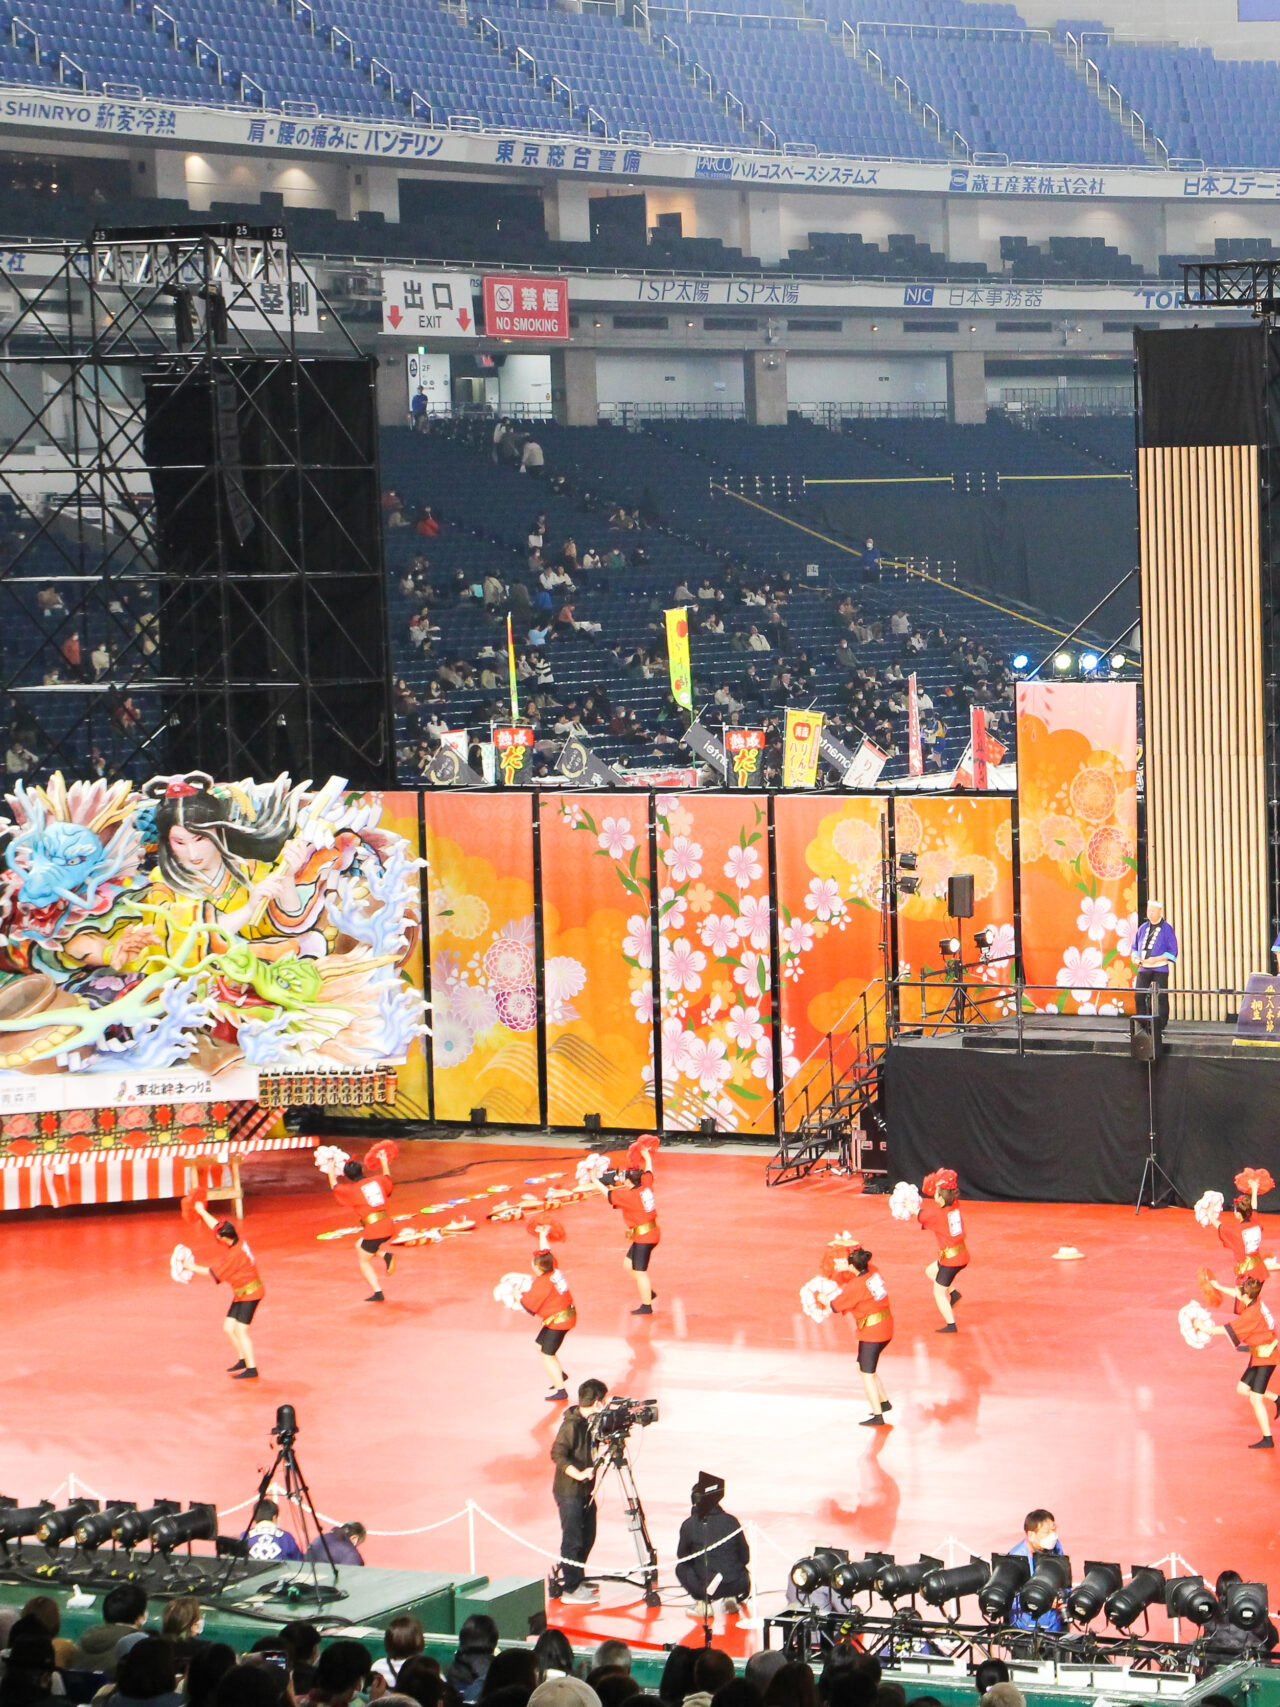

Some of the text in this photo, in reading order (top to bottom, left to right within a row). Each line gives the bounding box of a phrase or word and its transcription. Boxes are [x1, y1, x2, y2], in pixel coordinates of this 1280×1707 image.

[5, 101, 176, 134] SHINRYO 新菱冷熱
[247, 119, 358, 149] 肩・腰の痛みに
[495, 140, 642, 173] 東京総合警備
[697, 156, 733, 172] PARCO
[733, 159, 880, 184] パルコスペースシステムズ
[971, 174, 1106, 194] 蔵王産業株式会社
[403, 280, 453, 310] 出口
[521, 287, 560, 312] 禁煙
[637, 281, 710, 302] TSP太陽
[726, 282, 799, 304] TSP太陽
[906, 288, 932, 303] NJC
[949, 287, 1043, 307] 日本事務器
[418, 315, 442, 328] EXIT
[496, 317, 559, 332] NO SMOKING
